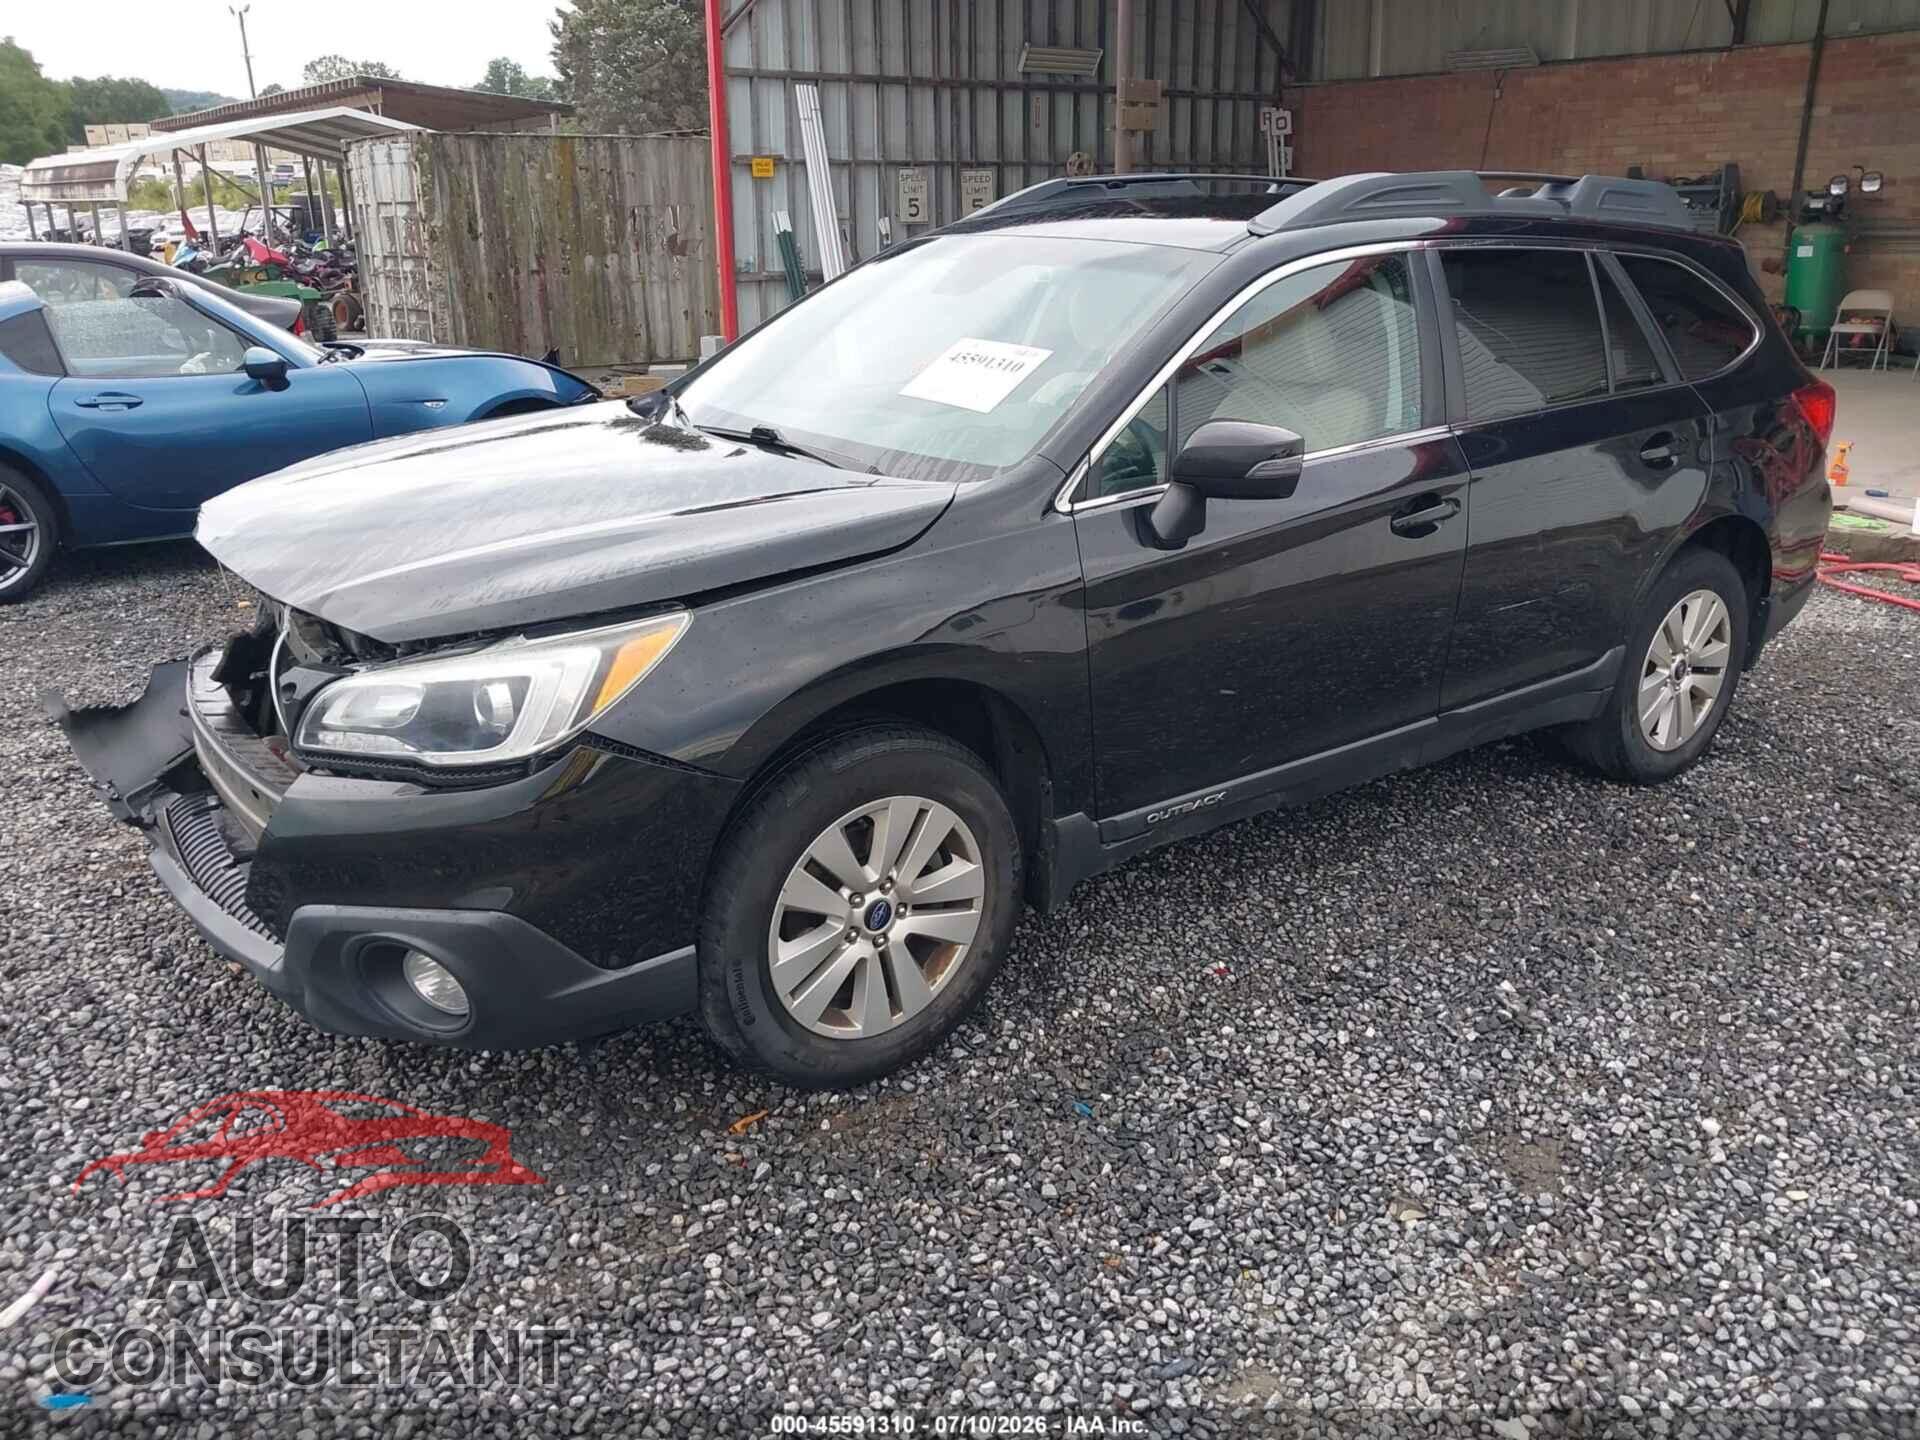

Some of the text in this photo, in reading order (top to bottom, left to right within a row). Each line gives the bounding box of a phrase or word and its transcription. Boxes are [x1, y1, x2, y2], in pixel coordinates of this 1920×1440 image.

[900, 174, 926, 182] SPEED
[962, 175, 991, 184] SPEED
[904, 185, 923, 194] LIMIT
[966, 187, 988, 195] LIMIT
[908, 197, 920, 217] 5
[1147, 792, 1227, 823] OUTBACK
